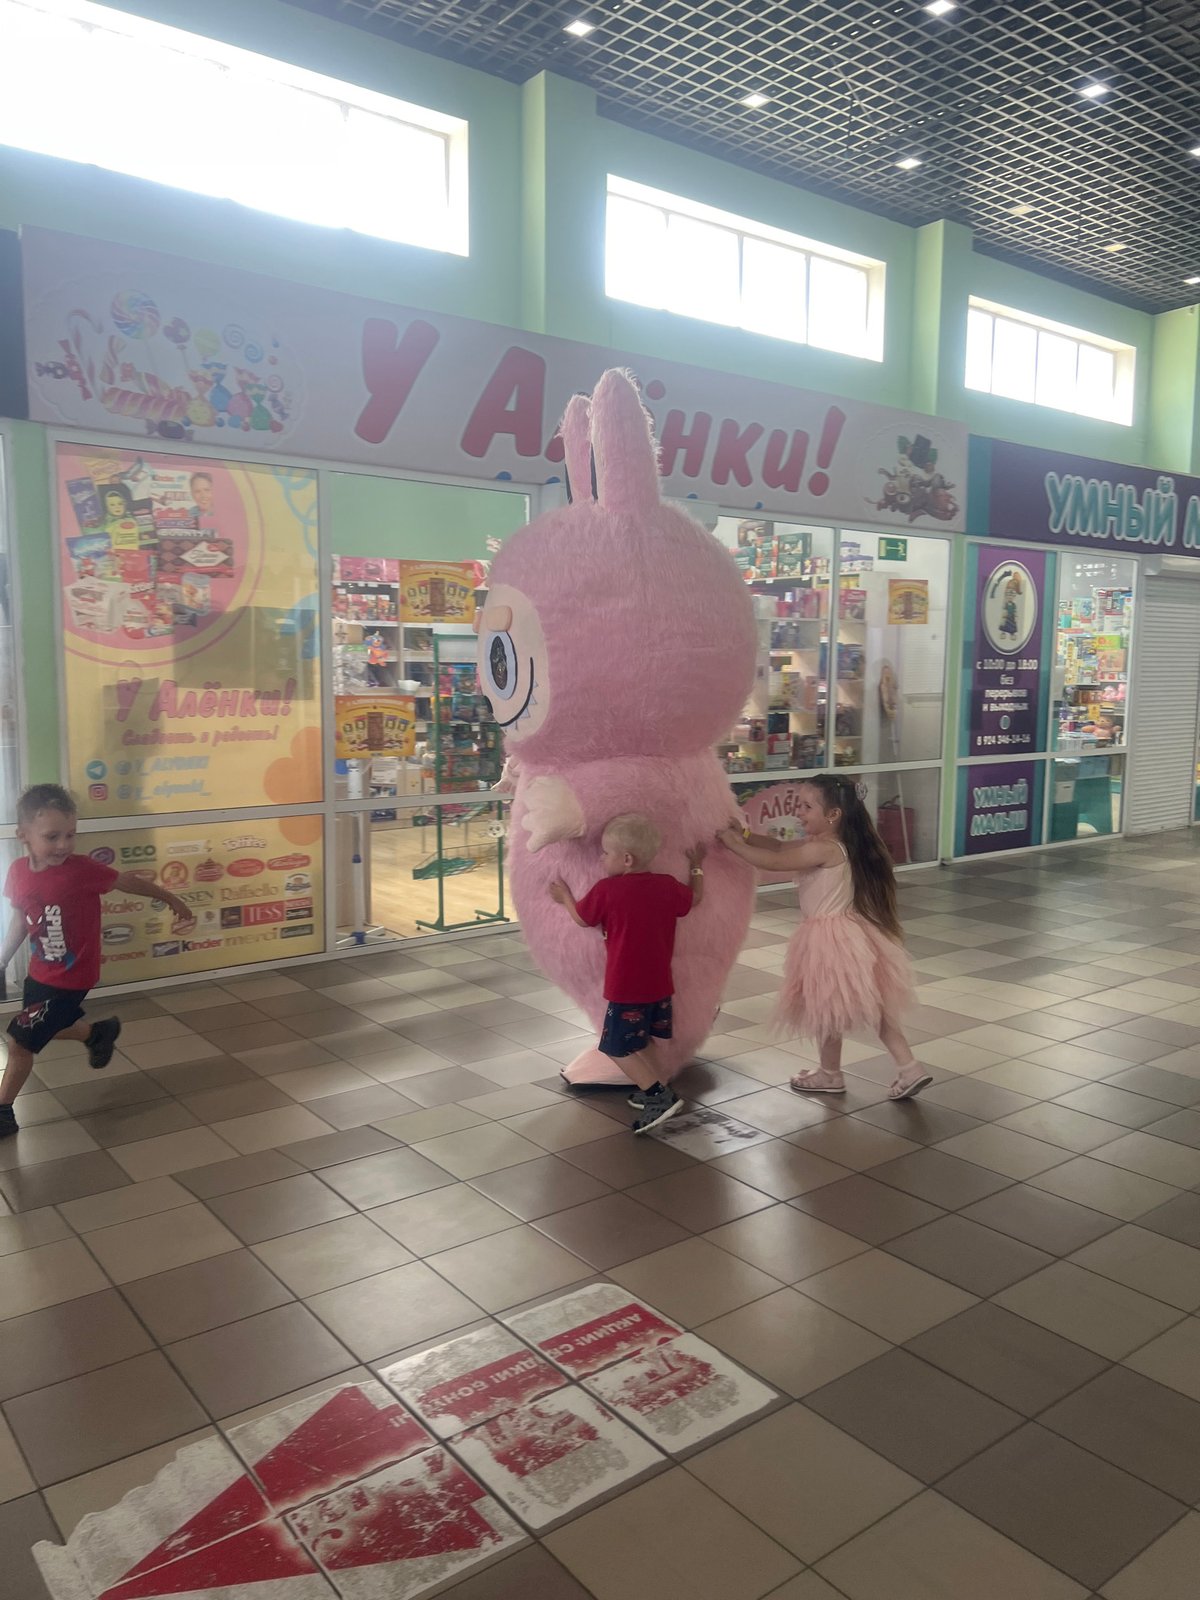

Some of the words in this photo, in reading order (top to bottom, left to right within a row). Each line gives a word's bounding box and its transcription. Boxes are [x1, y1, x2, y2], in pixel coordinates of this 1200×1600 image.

[354, 317, 440, 444] У
[460, 346, 847, 496] Анки!
[1045, 471, 1178, 547] УМНЫЙ
[115, 676, 143, 722] У
[148, 676, 297, 721] Алёнки!
[973, 778, 1028, 808] УМНЫЙ
[970, 810, 1028, 837] МАЛЫШ
[120, 845, 156, 858] ECO
[248, 904, 282, 923] TESS
[224, 927, 278, 946] merci
